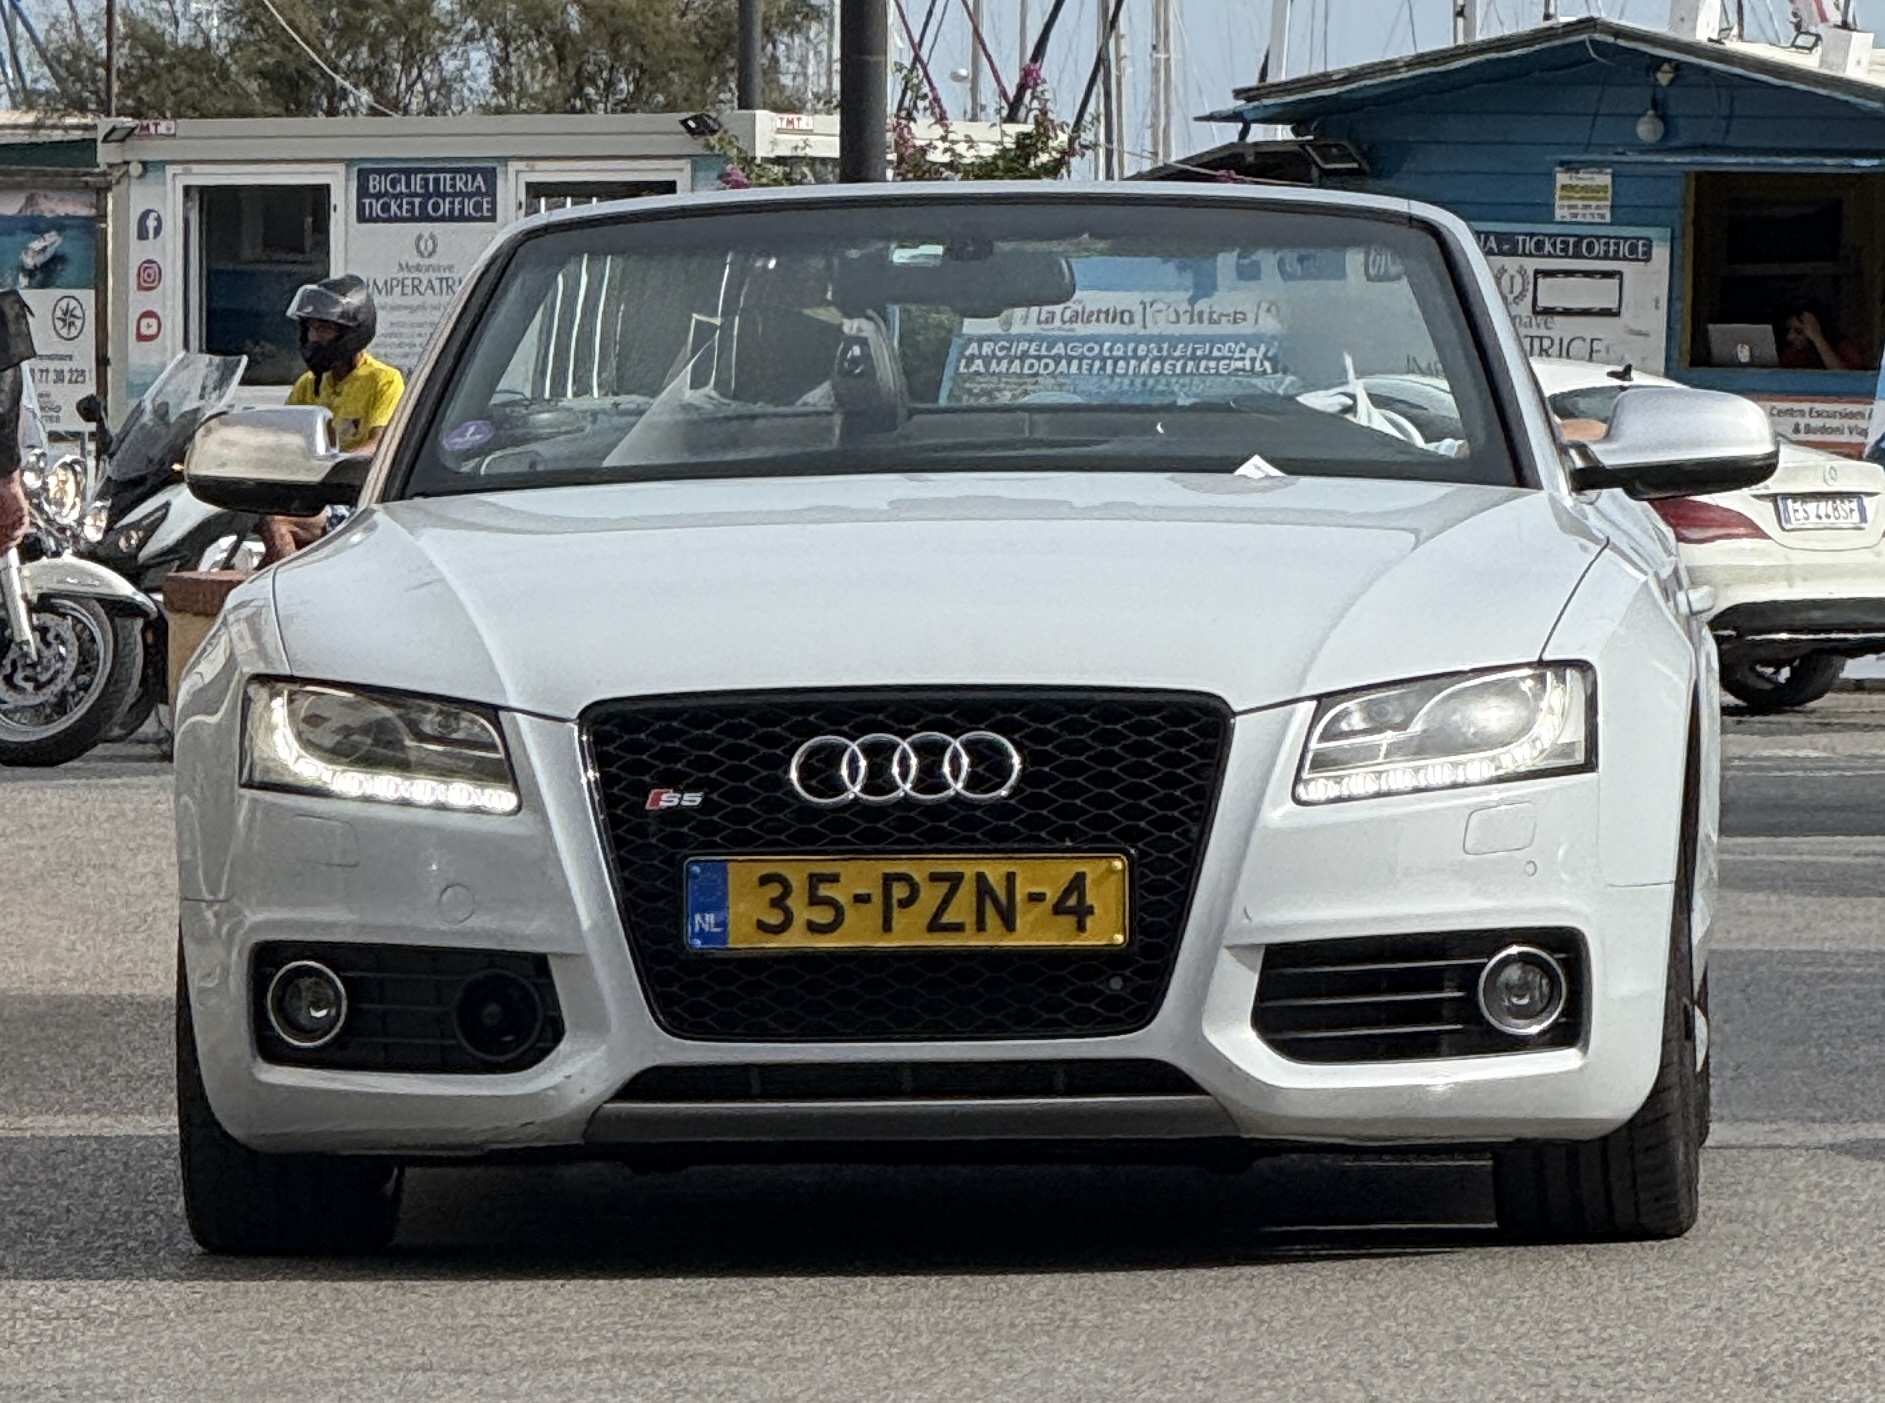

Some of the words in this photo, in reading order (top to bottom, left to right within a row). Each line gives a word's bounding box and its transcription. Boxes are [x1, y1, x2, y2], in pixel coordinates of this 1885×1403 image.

[778, 116, 803, 129] TMT
[368, 172, 487, 194] BIGLIETTERIA
[361, 198, 422, 218] TICKET
[427, 196, 493, 217] OFFICE
[1515, 234, 1580, 257] TICKET
[1582, 236, 1650, 260] OFFICE
[963, 340, 1101, 358] ARCIPELAGO
[755, 870, 1096, 935] 35-PZN-4
[693, 912, 725, 933] NL
